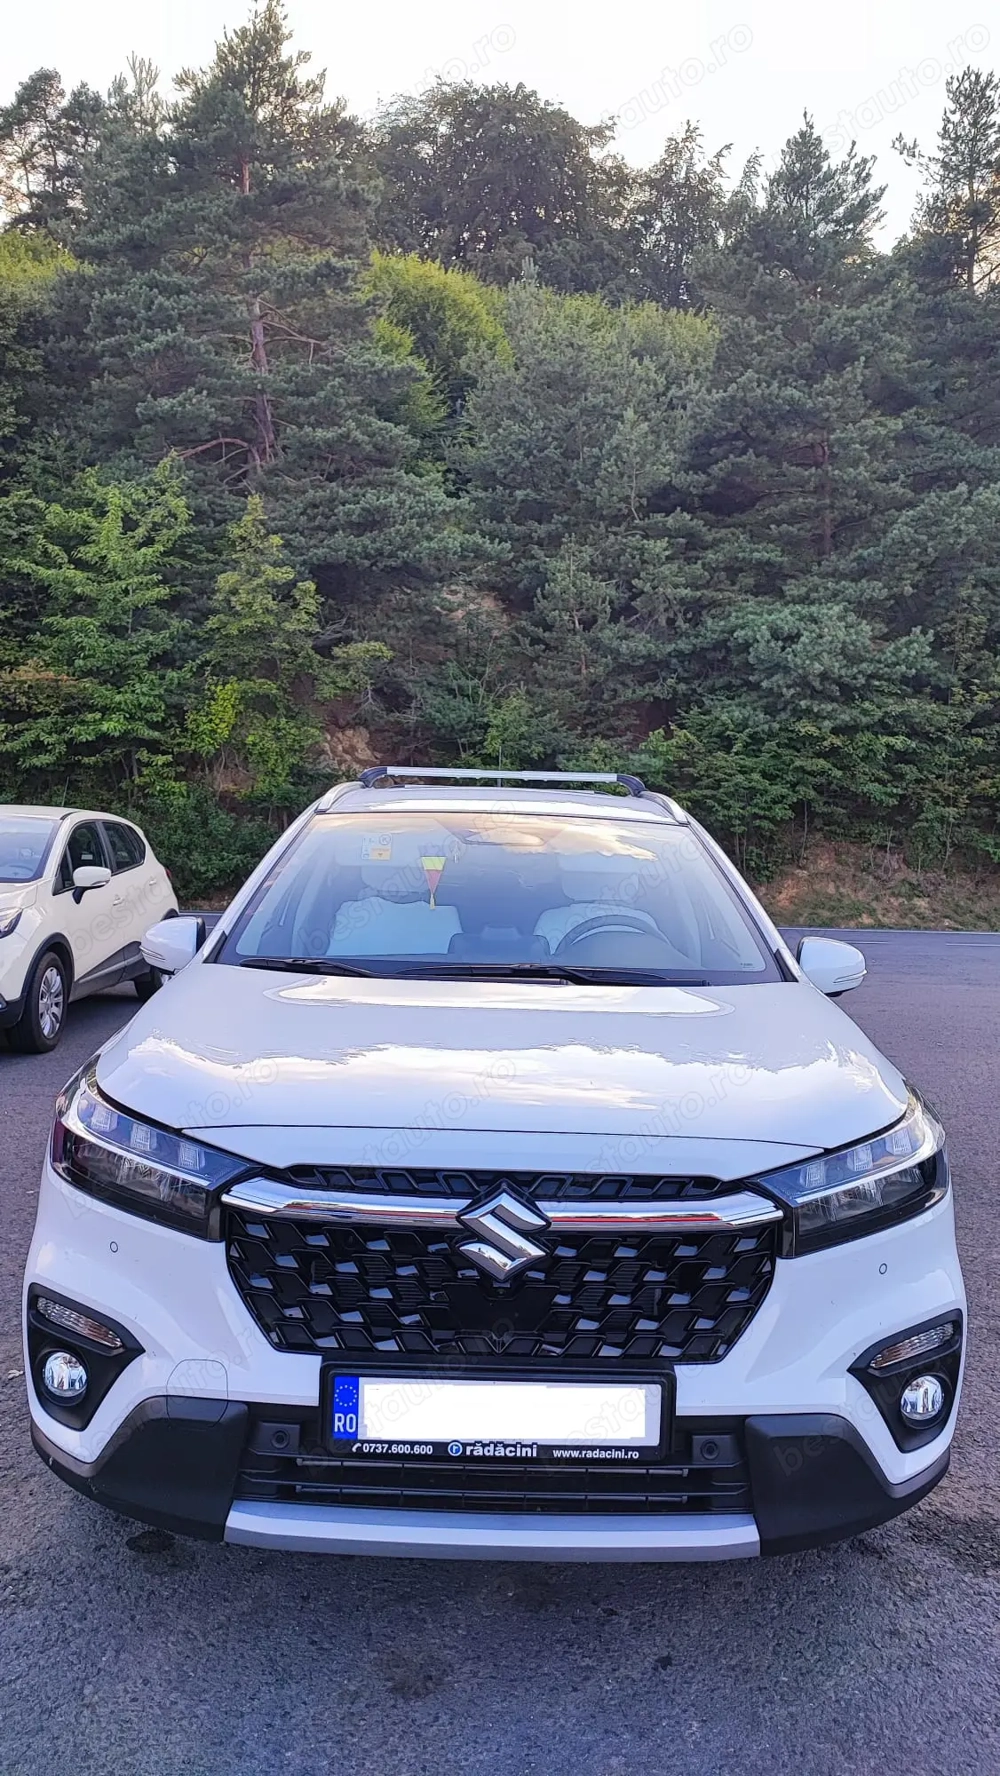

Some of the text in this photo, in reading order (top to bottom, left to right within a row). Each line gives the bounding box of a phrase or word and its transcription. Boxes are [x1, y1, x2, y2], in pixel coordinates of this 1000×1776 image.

[334, 1413, 357, 1433] RO
[362, 1443, 433, 1455] 0737.600.600
[552, 1448, 640, 1459] www.radacini.ro
